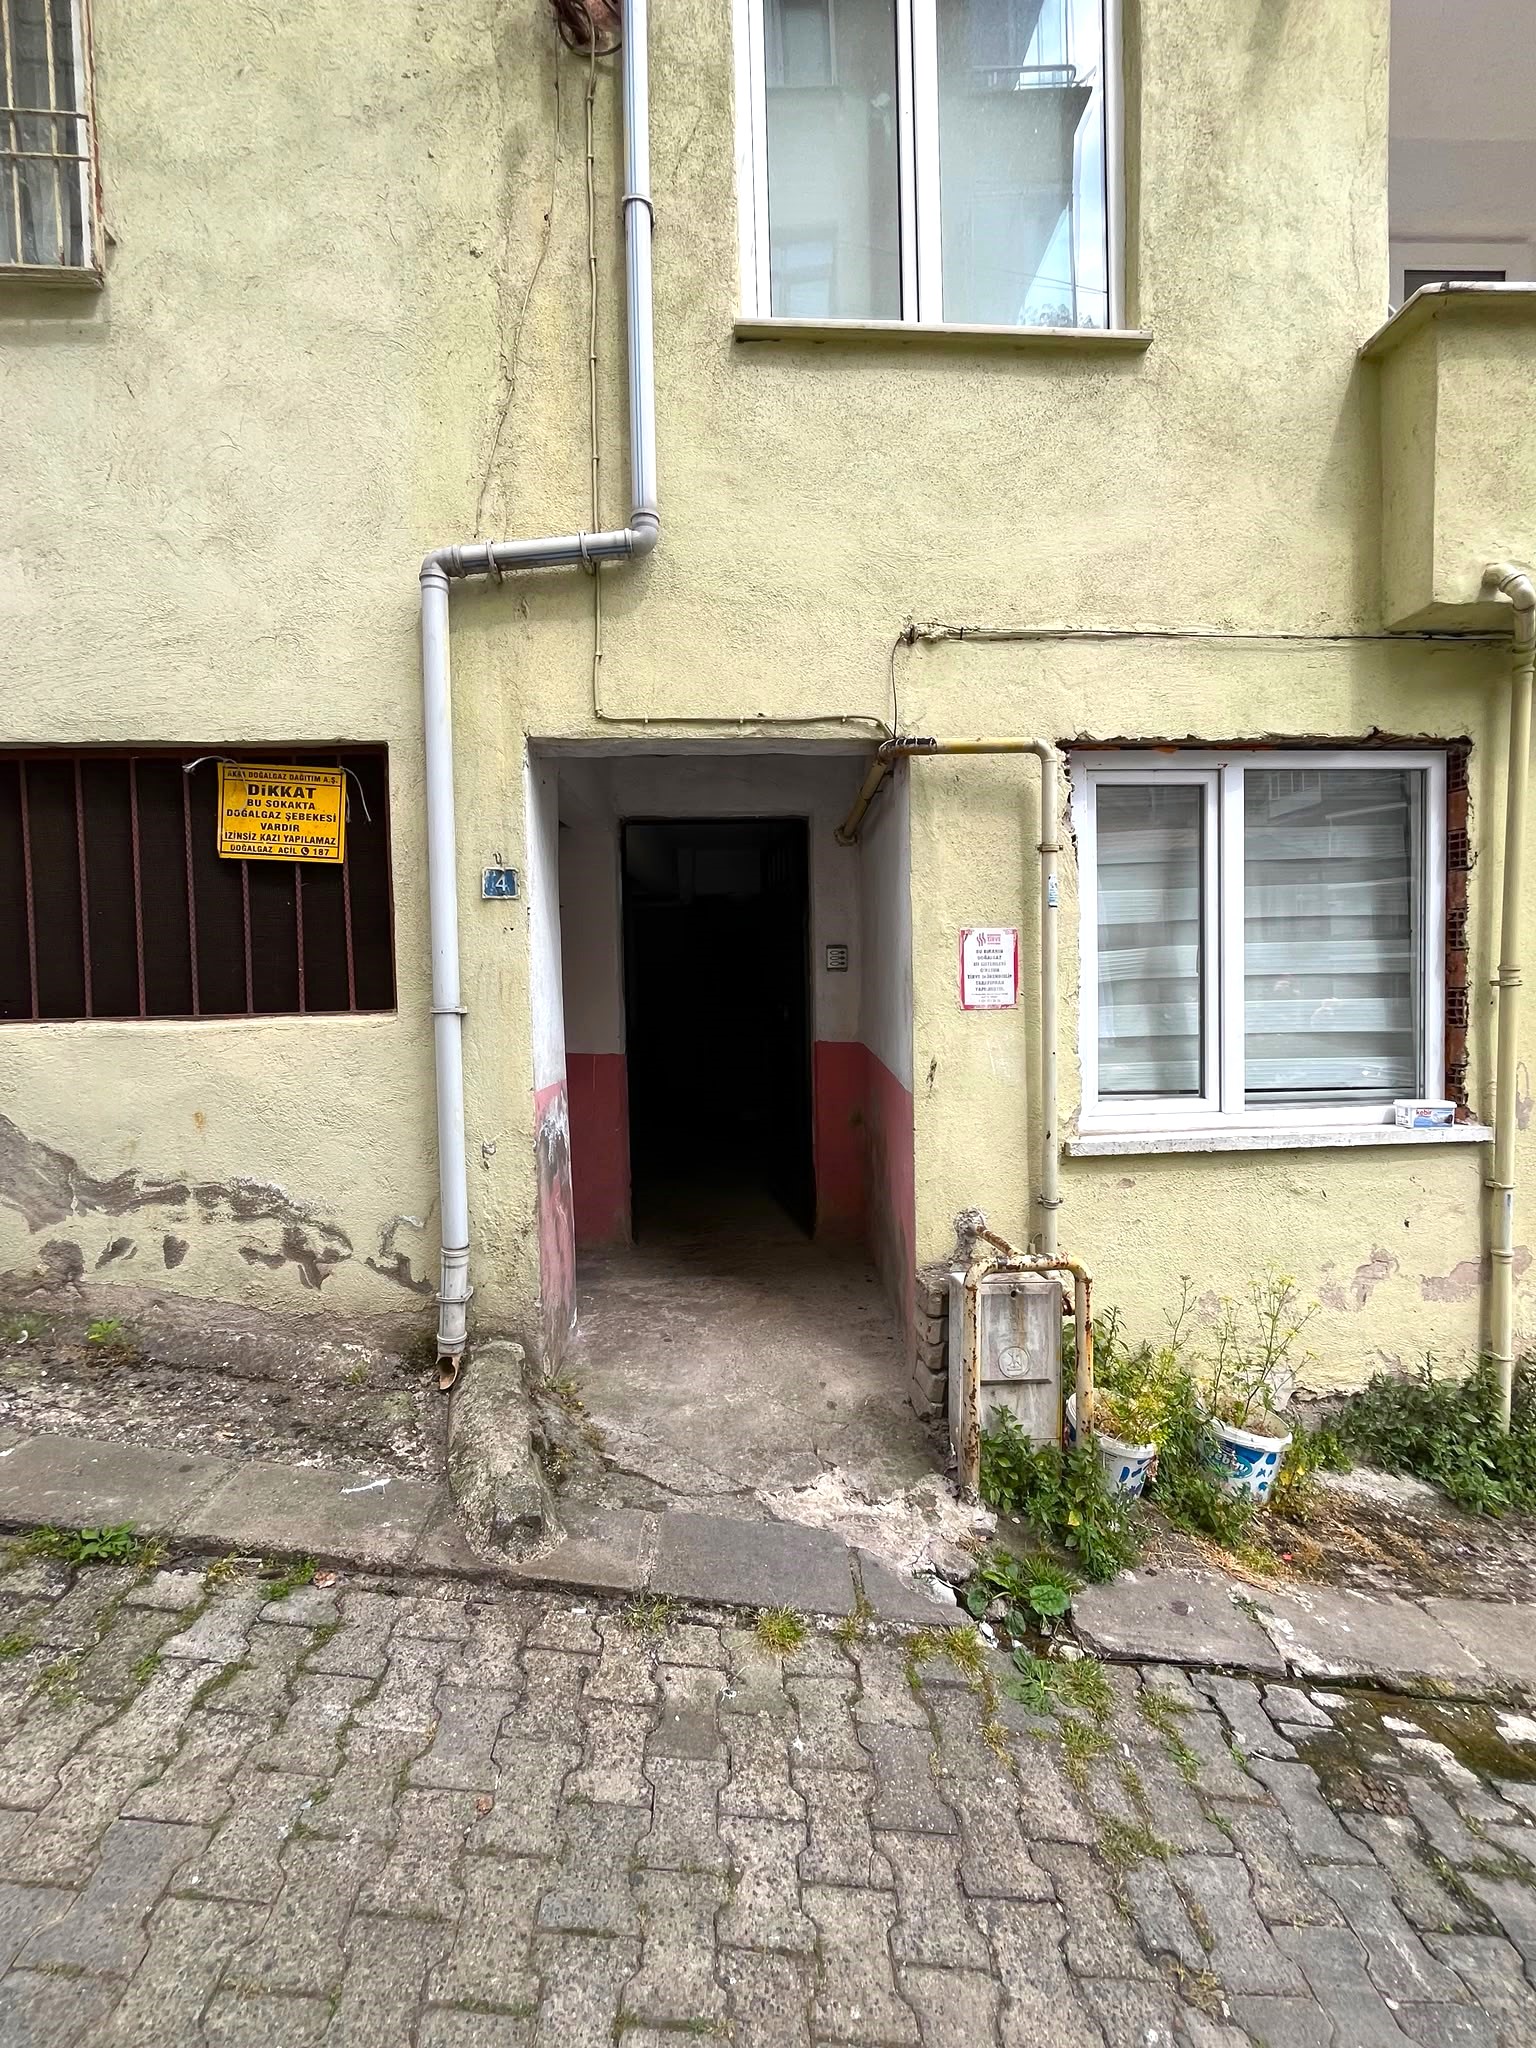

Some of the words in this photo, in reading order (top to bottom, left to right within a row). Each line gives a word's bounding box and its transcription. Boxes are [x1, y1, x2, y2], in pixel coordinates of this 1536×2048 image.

[248, 771, 287, 780] DOĞALGAZ
[289, 773, 321, 782] DAĞITIM
[247, 799, 261, 807] BU
[265, 800, 315, 810] SOKAKTA
[226, 808, 281, 819] DOĞALGAZ
[285, 812, 336, 822] ŞEBEKESİ
[260, 823, 299, 832] VARDIR
[260, 833, 280, 842] KAZI
[284, 835, 336, 845] YAPILAMAZ
[230, 844, 273, 853] DOĞALGAZ
[278, 845, 297, 854] ACİL
[313, 848, 329, 856] 187
[495, 874, 508, 892] 4
